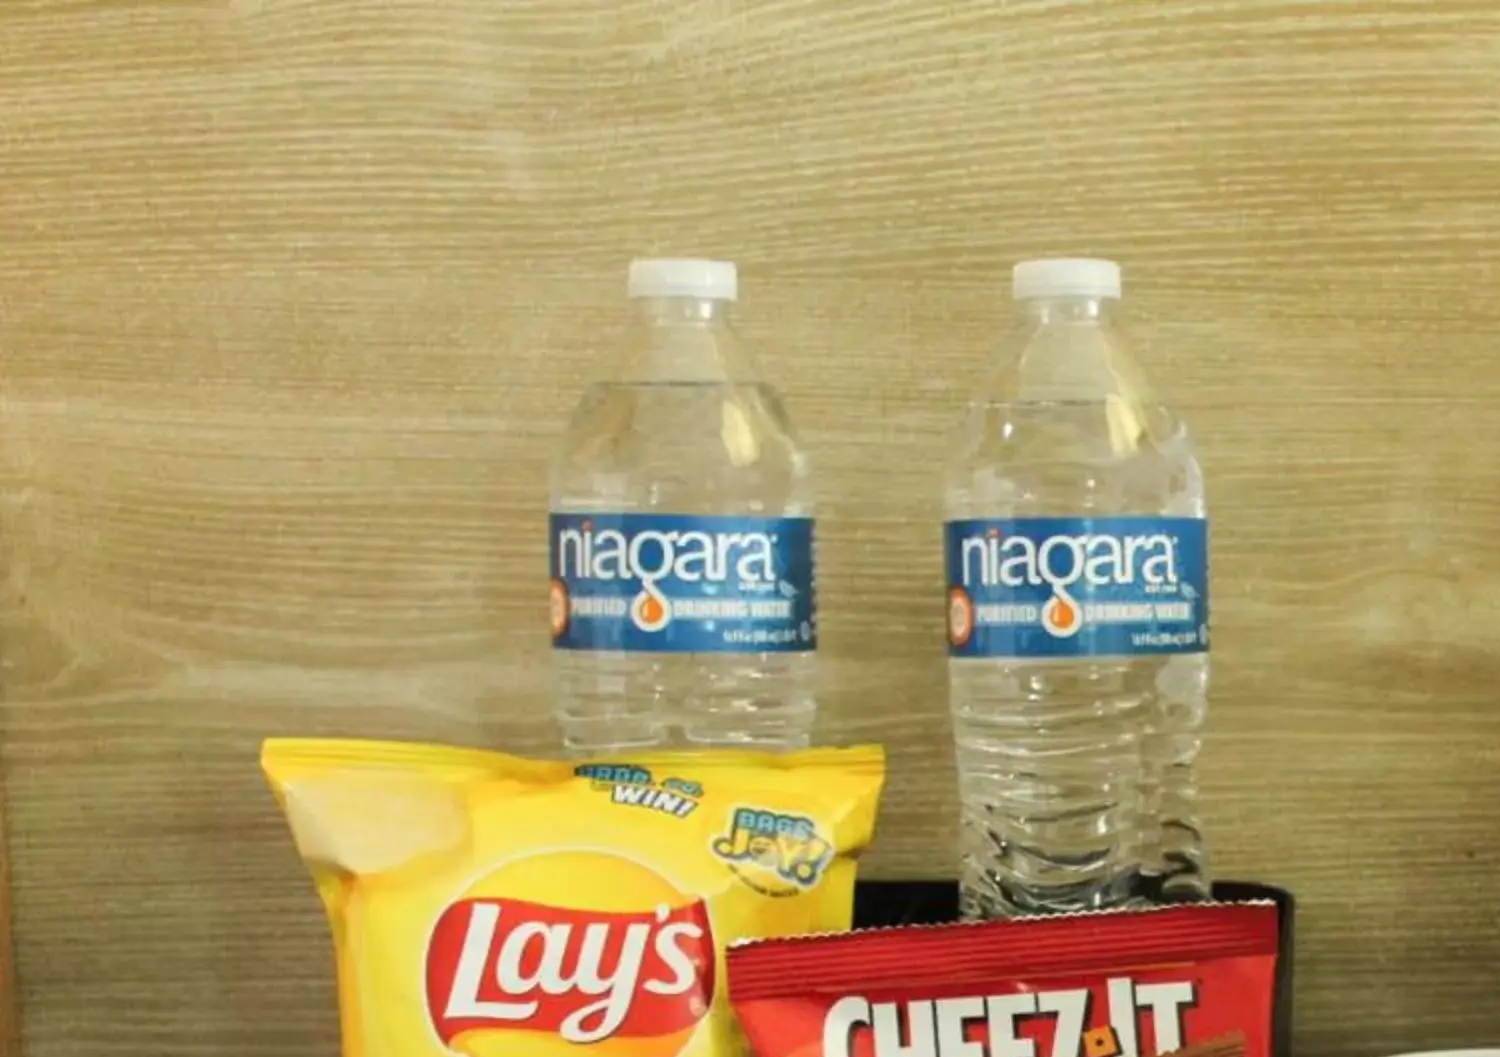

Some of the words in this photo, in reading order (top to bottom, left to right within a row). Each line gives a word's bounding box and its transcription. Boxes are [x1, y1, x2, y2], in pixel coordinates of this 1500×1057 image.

[558, 520, 776, 632] niagara
[962, 528, 1178, 637] niagara
[613, 784, 698, 817] WIN!
[443, 902, 704, 1044] Lay's
